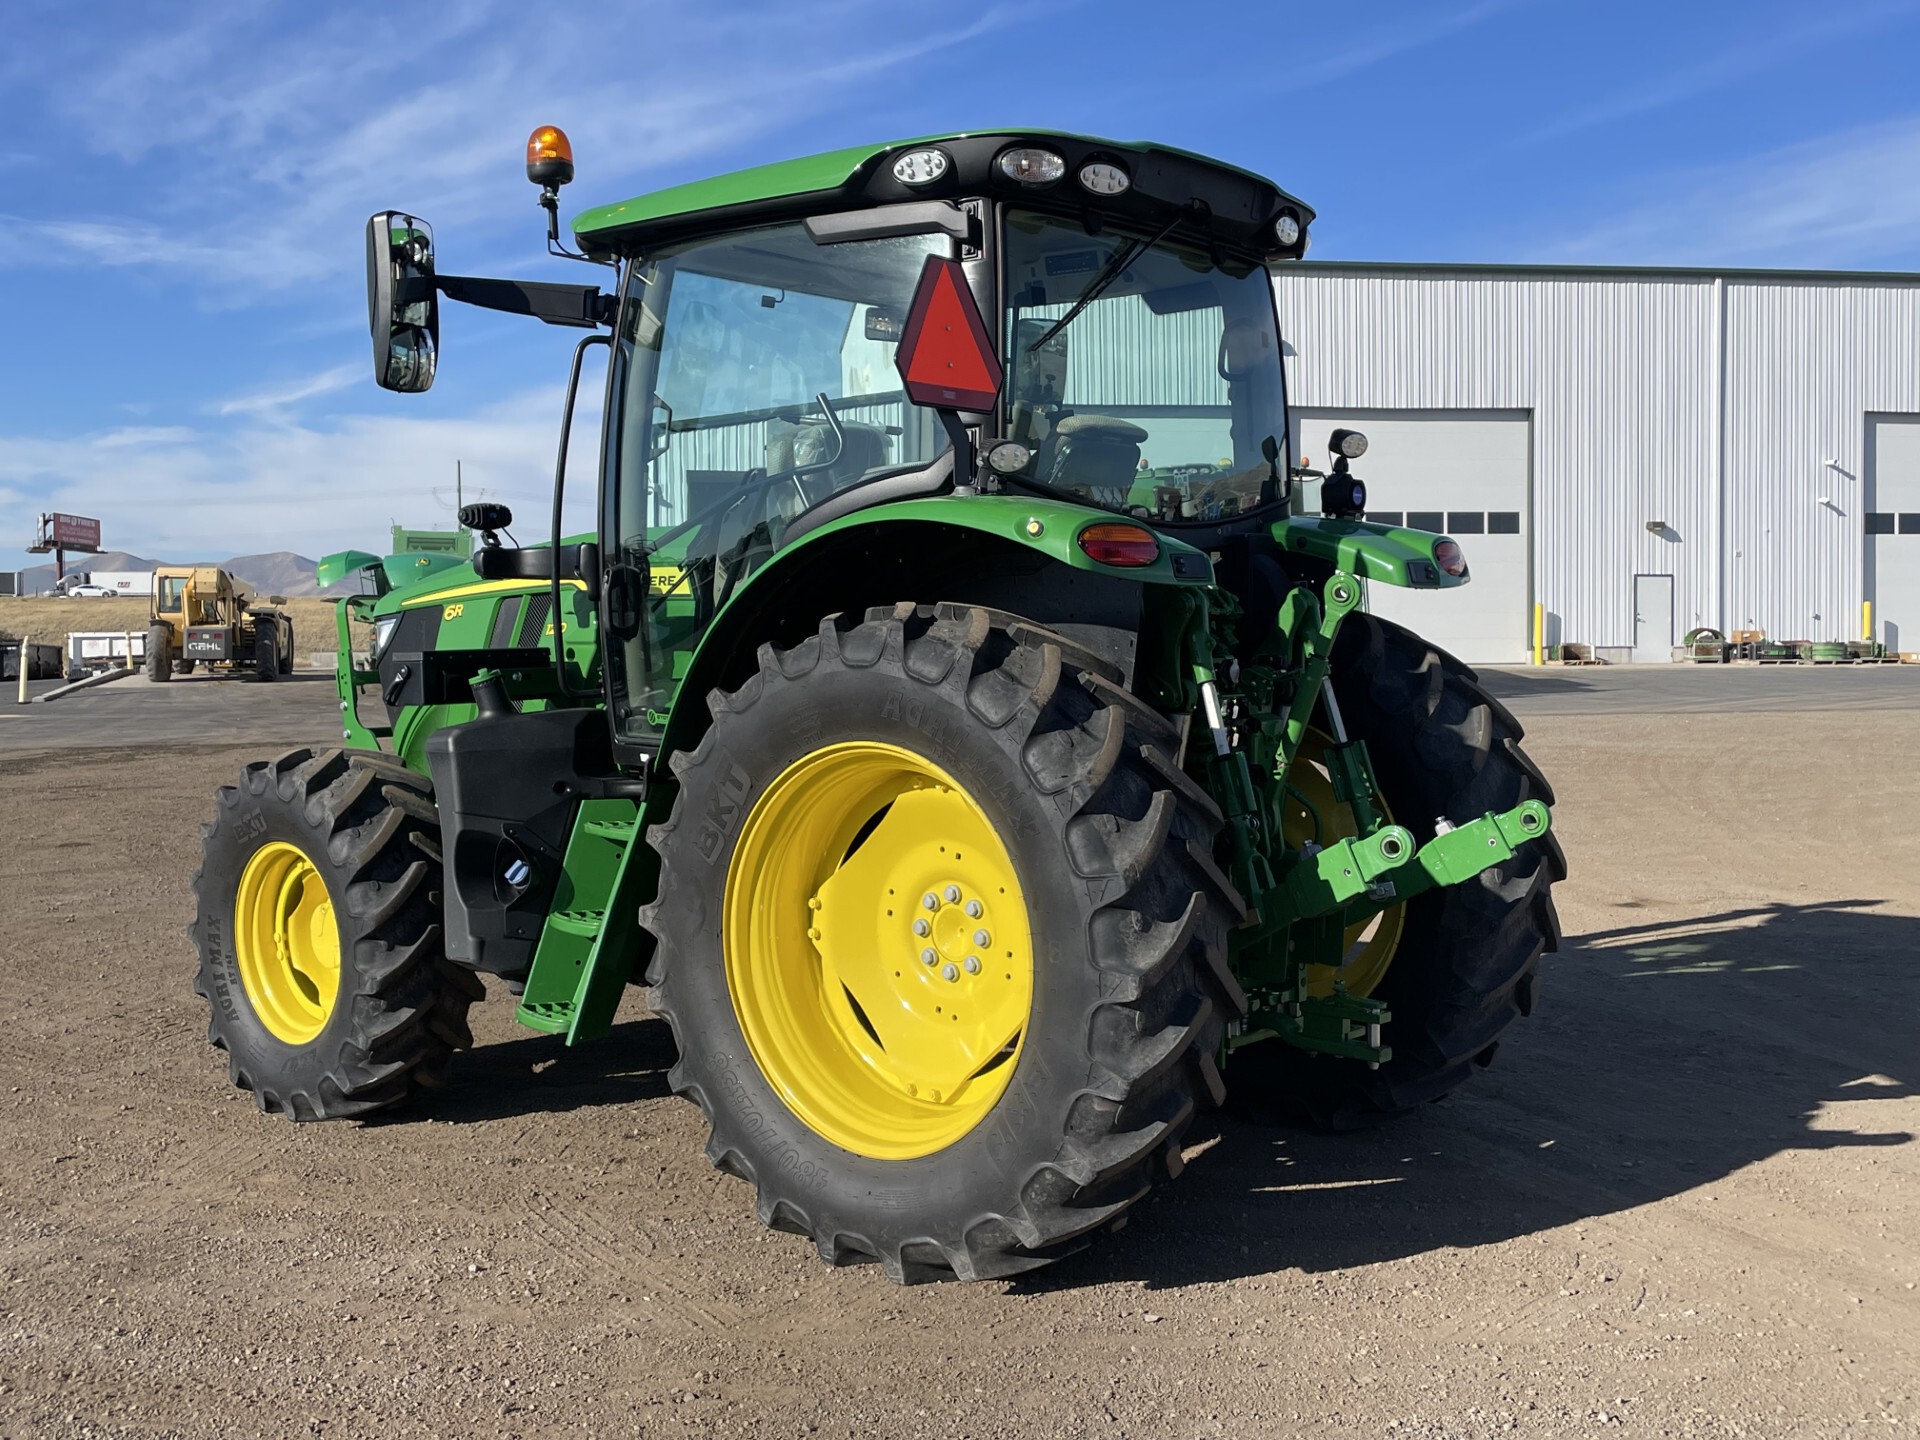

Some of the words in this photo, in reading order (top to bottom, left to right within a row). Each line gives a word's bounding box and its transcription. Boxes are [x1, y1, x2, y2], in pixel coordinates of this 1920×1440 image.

[650, 575, 677, 586] ERE
[443, 603, 464, 621] 6R
[188, 642, 222, 651] GEHL
[693, 760, 754, 866] BKT
[207, 914, 223, 967] MAX
[212, 971, 240, 1024] AGRI
